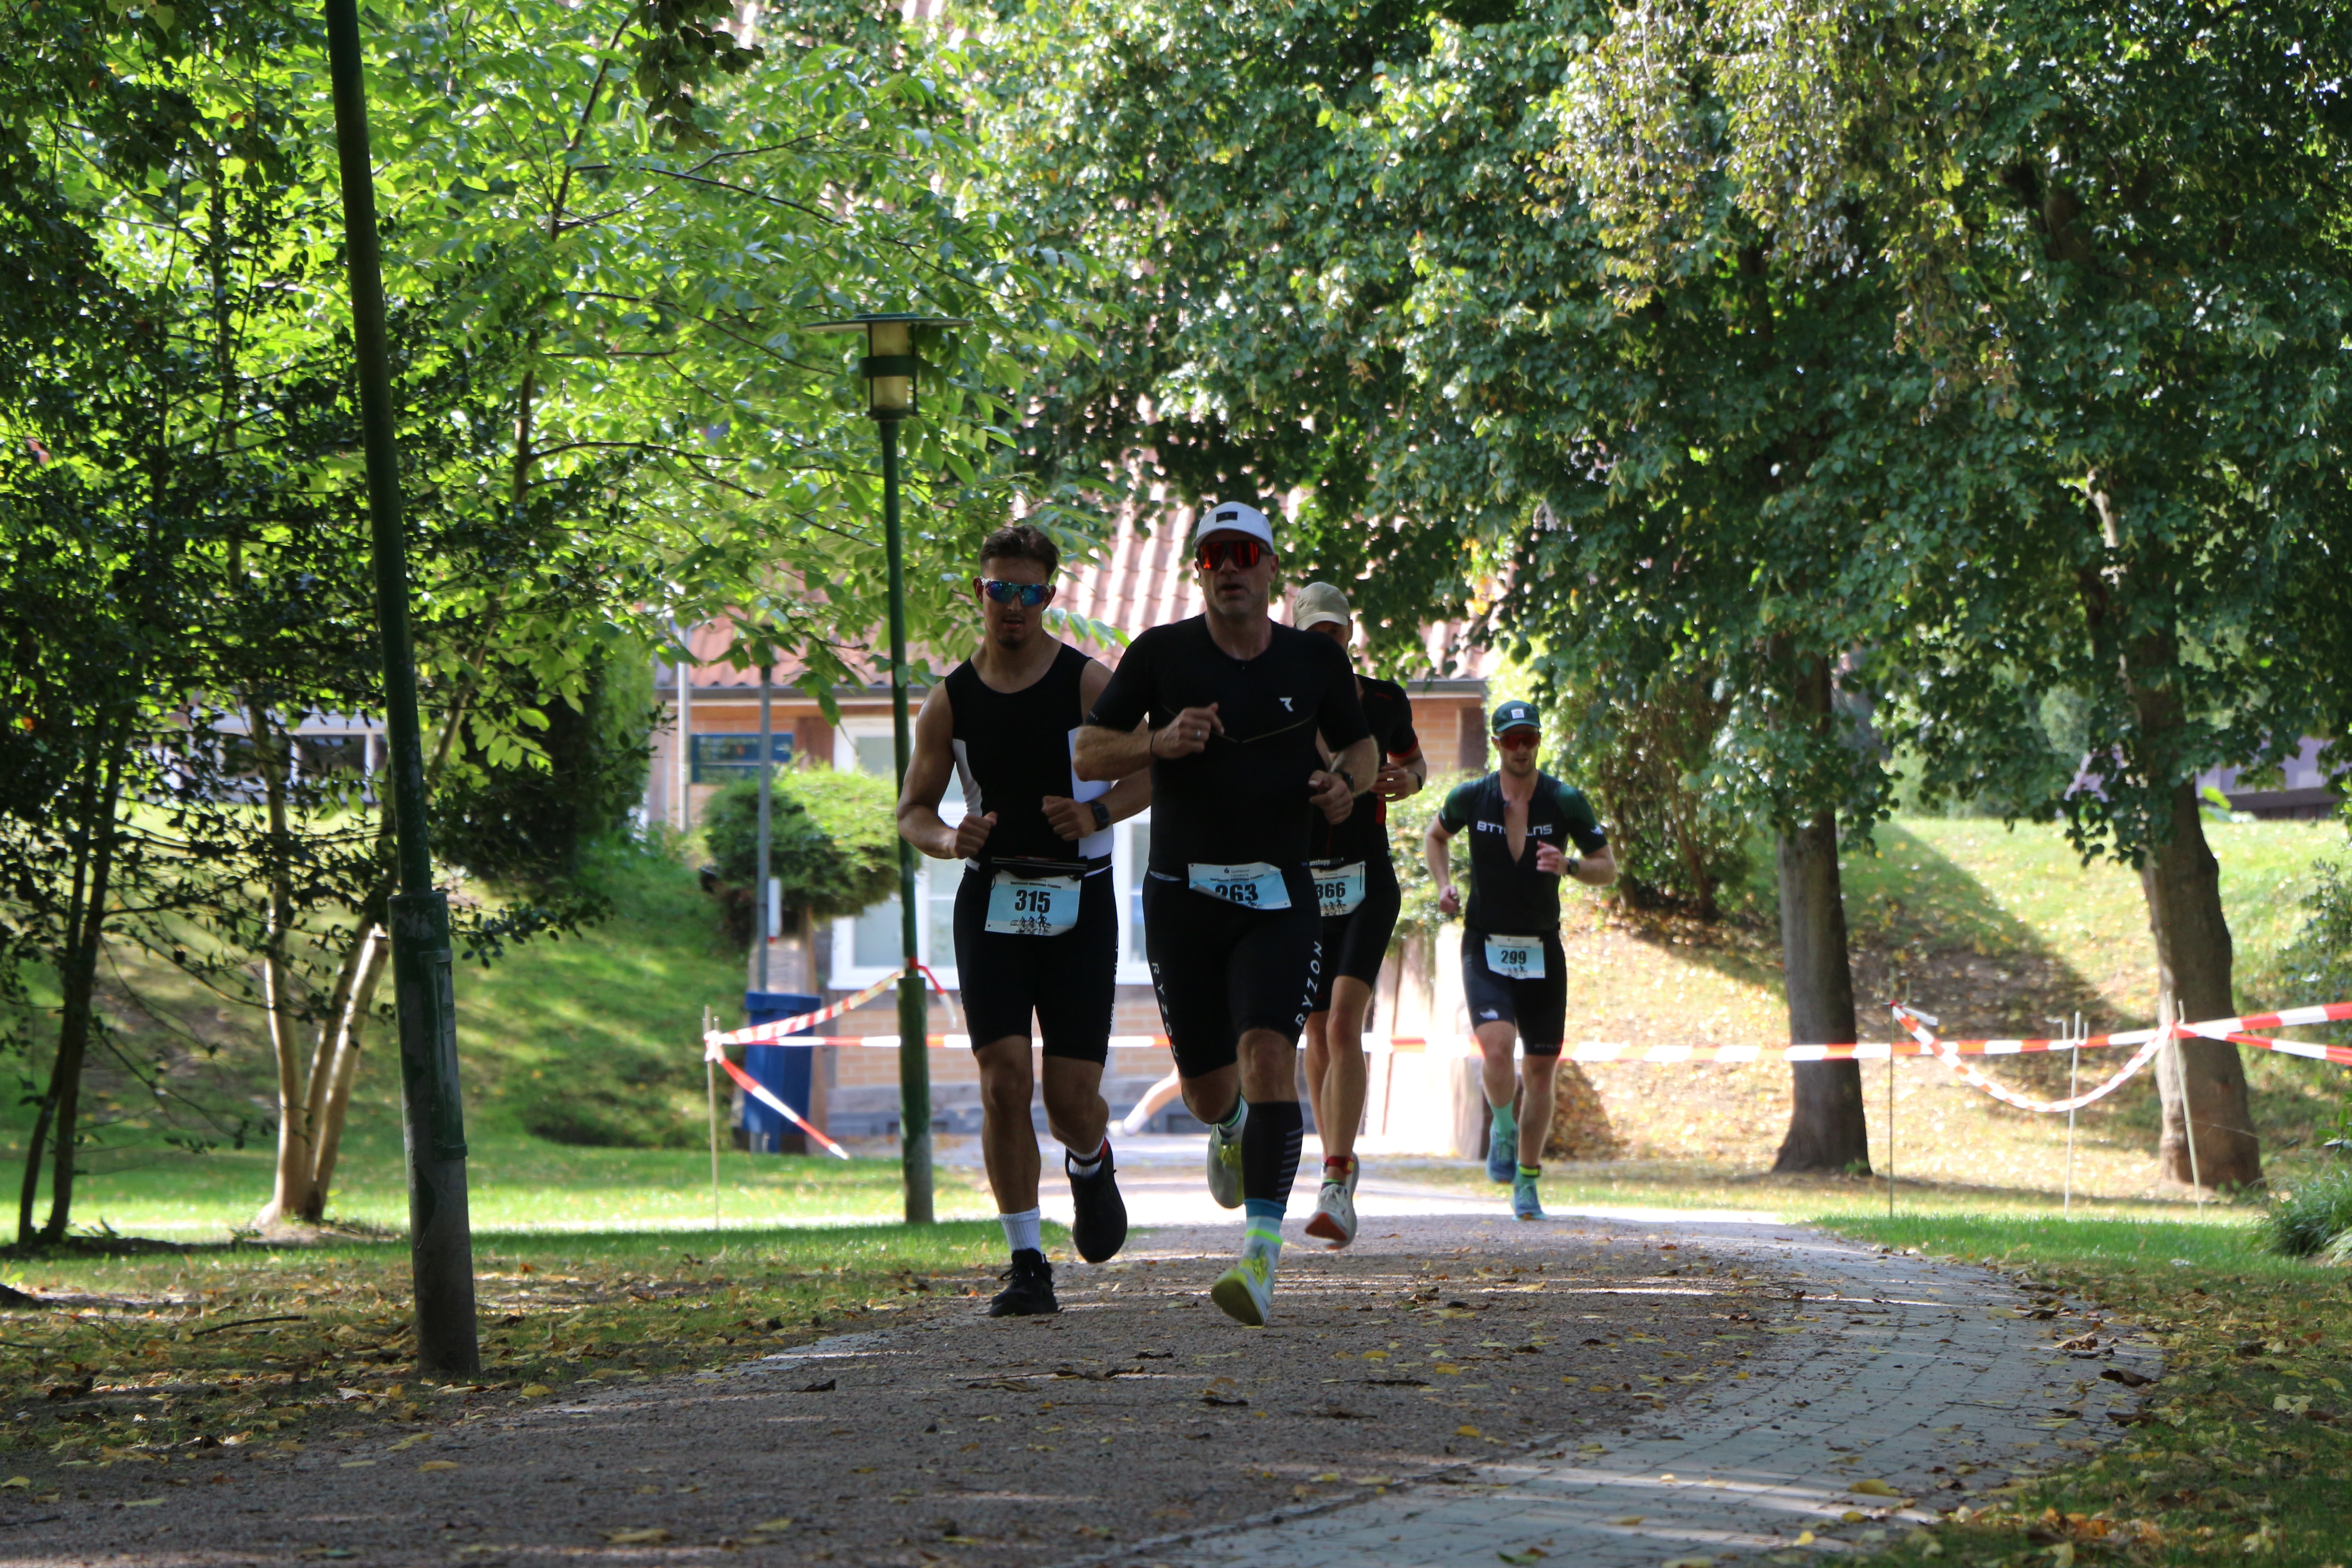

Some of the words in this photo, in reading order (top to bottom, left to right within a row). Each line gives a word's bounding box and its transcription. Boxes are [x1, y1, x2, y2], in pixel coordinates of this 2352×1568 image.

[1215, 883, 1259, 902] 263
[1316, 882, 1346, 899] 366
[1014, 889, 1051, 914] 315
[1501, 950, 1527, 965] 299
[1294, 941, 1322, 1027] RYZON
